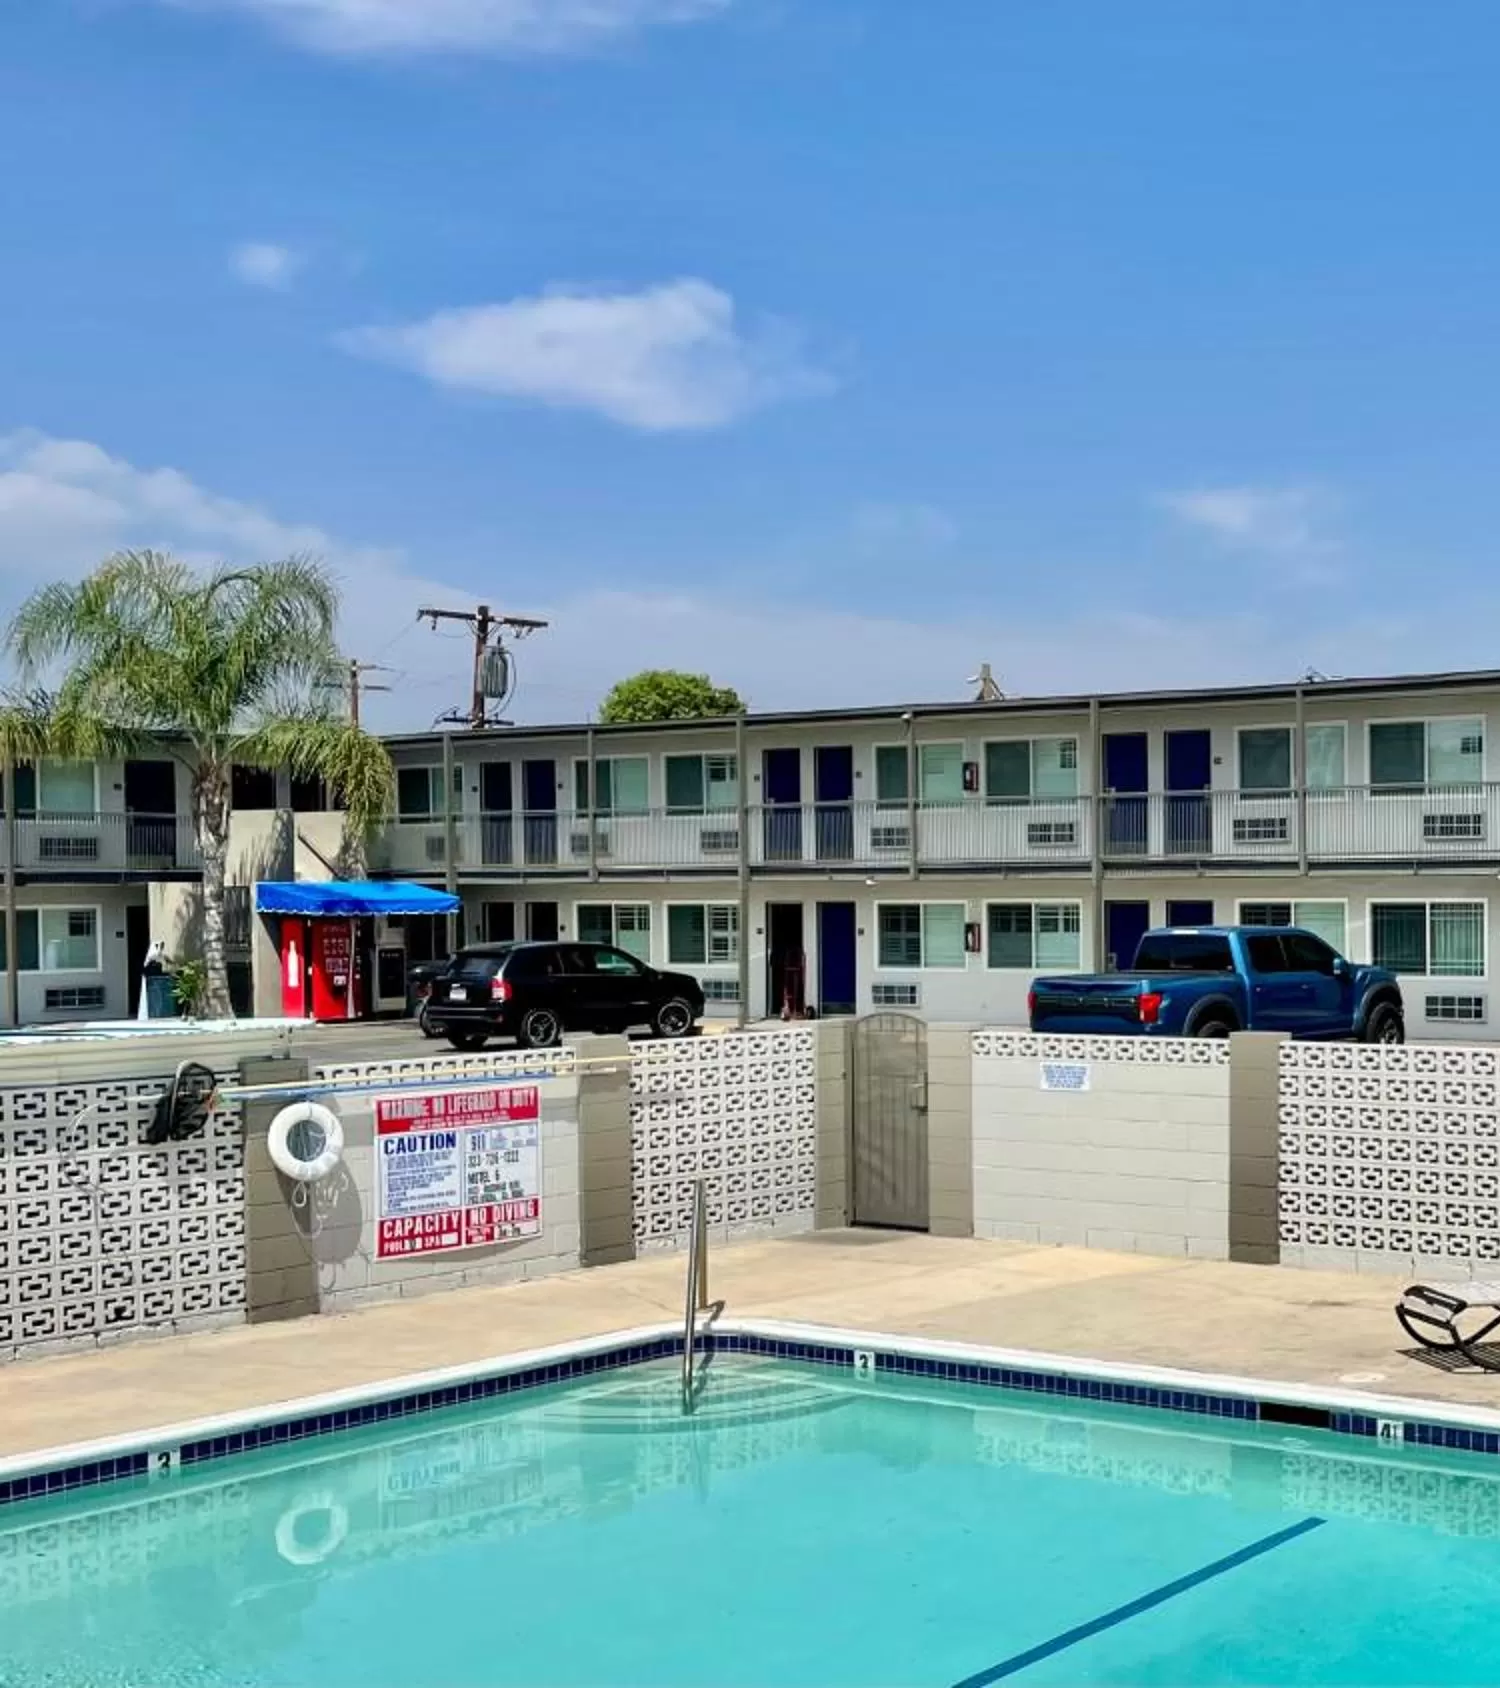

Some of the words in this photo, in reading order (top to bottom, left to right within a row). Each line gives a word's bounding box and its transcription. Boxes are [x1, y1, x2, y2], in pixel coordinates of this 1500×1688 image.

[384, 1132, 457, 1155] CAUTION
[383, 1211, 459, 1239] CAPACITY
[470, 1206, 487, 1226] NO
[493, 1198, 535, 1222] DIVING
